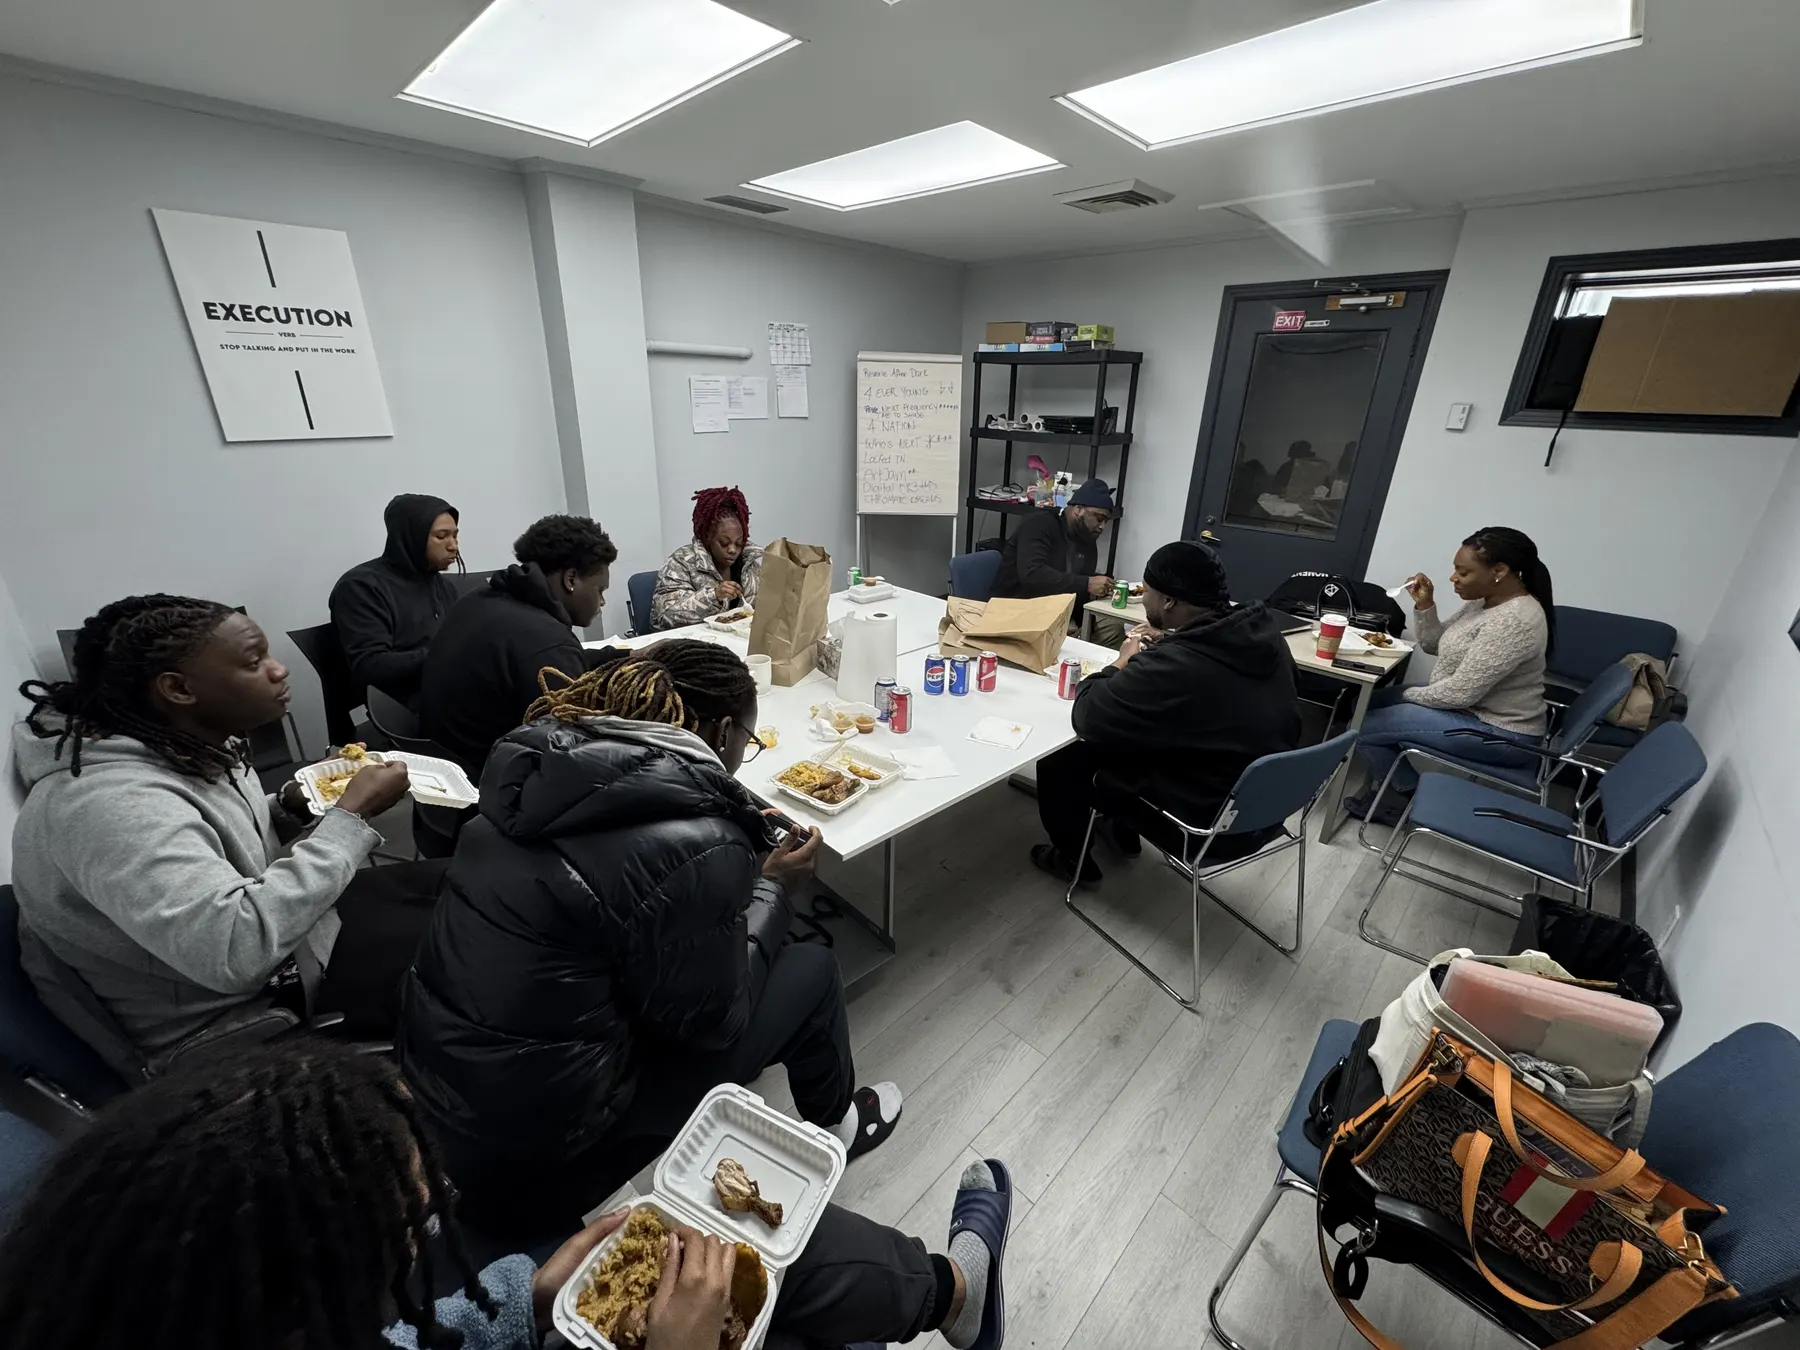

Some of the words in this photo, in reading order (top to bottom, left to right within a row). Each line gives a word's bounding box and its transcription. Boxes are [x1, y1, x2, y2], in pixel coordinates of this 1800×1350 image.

[202, 301, 353, 327] EXECUTION
[1275, 315, 1304, 327] EXIT
[909, 367, 929, 379] Dark
[863, 386, 873, 400] 4
[875, 386, 898, 398] EVER
[900, 386, 929, 398] YOUNG
[867, 419, 876, 433] 4
[1475, 1191, 1573, 1274] GUESS
